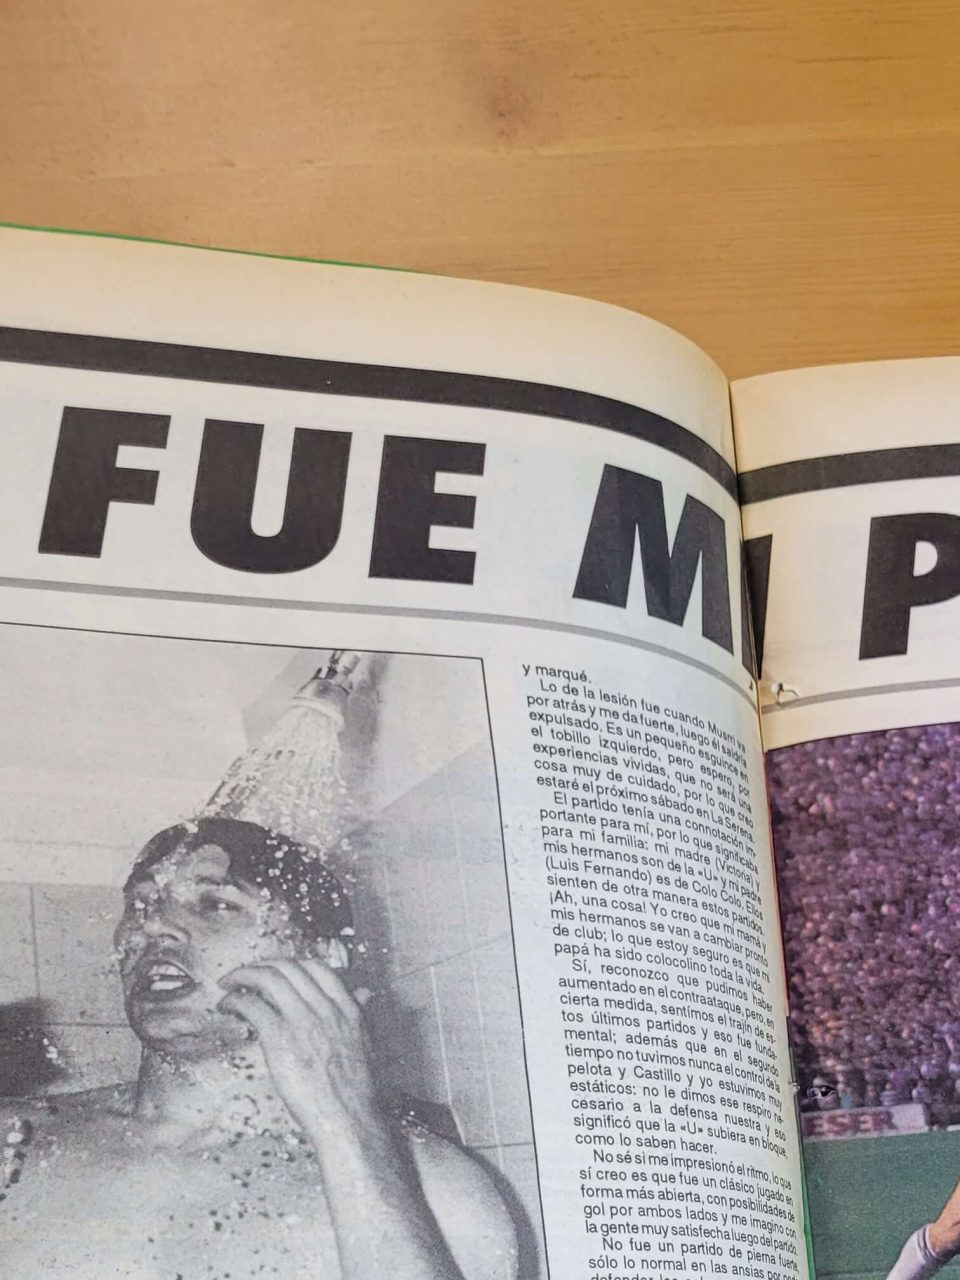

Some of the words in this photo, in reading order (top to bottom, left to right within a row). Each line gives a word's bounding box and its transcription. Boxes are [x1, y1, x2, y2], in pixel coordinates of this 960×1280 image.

[38, 406, 486, 586] FUE
[521, 663, 531, 677] y
[535, 665, 592, 684] marqué.
[539, 678, 558, 693] Lo
[561, 682, 579, 697] de
[582, 685, 596, 700] la
[599, 688, 638, 709] lesión
[640, 698, 661, 715] fue
[663, 707, 705, 729] cuando
[564, 1028, 617, 1045] mental;
[625, 1031, 679, 1049] además
[685, 1041, 707, 1055] que
[713, 1046, 728, 1059] en
[733, 1048, 743, 1062] el
[575, 1133, 615, 1146] como
[619, 1132, 632, 1147] lo
[635, 1134, 677, 1150] saben
[680, 1137, 717, 1155] hacer.
